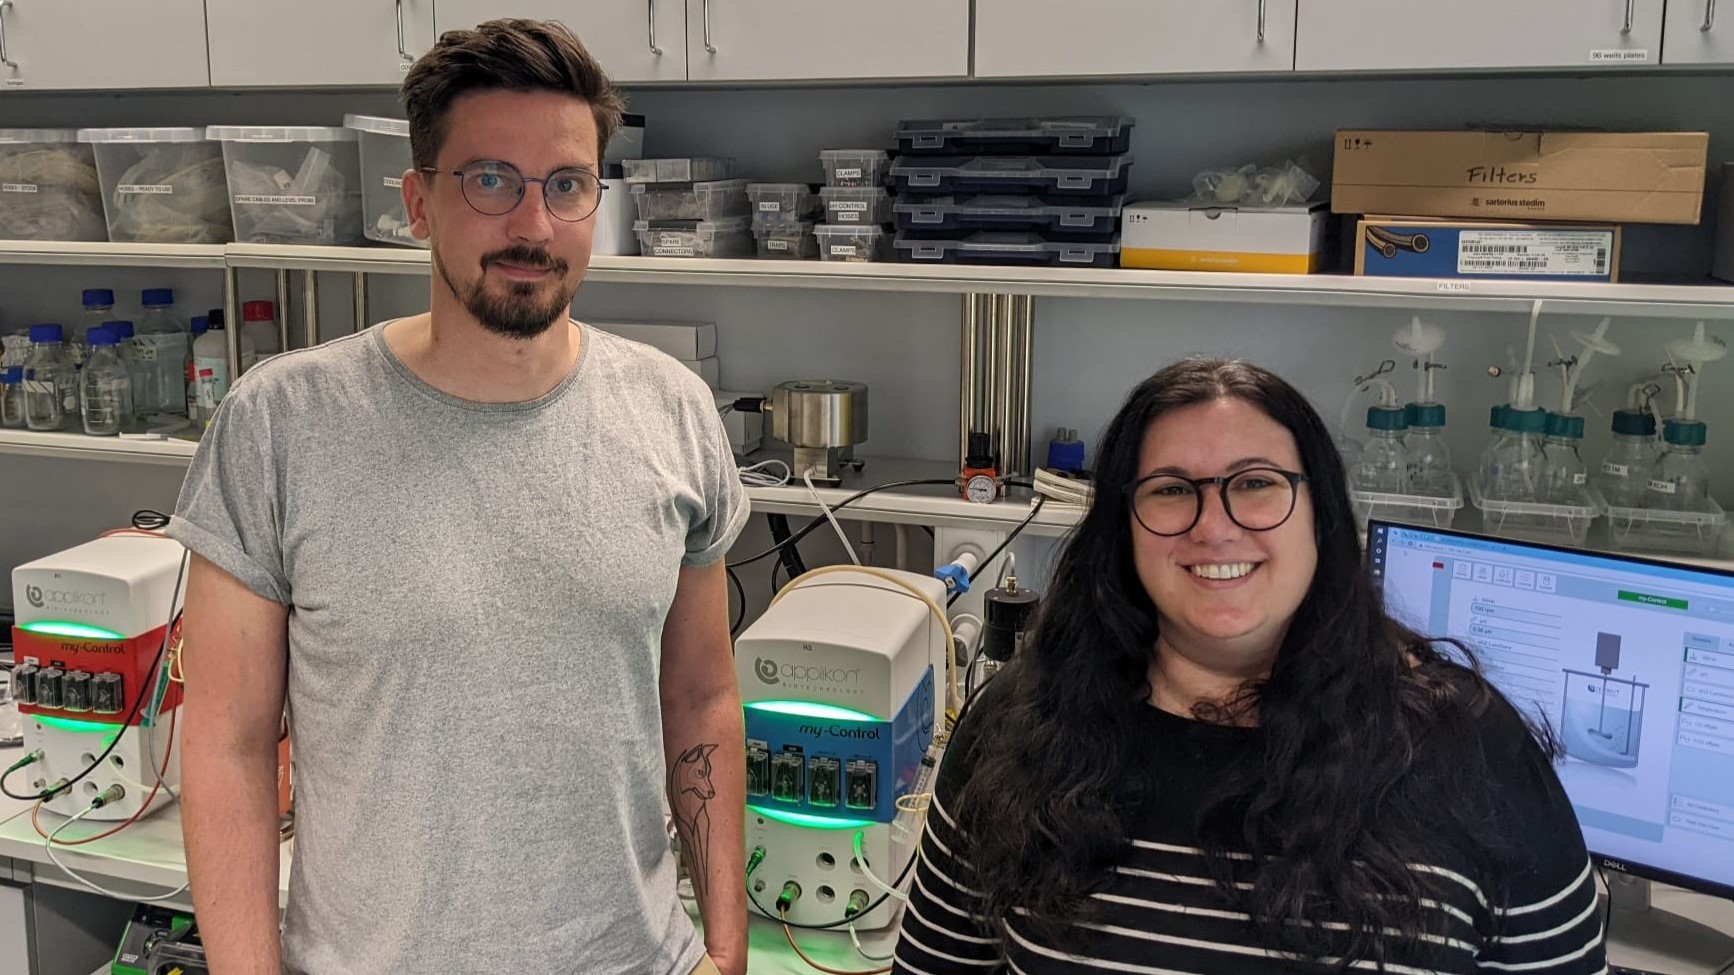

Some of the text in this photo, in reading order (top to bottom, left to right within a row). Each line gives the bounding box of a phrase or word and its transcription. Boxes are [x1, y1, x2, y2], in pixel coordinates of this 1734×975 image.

[1592, 51, 1645, 60] 96 wells plates
[836, 169, 860, 177] CLAMPS
[1466, 166, 1538, 183] Filters
[1486, 198, 1546, 207] sartorius stedim
[654, 247, 693, 255] CONNECTORS
[1438, 282, 1470, 290] FILTERS
[44, 588, 106, 607] applikon
[61, 641, 126, 655] my-Control
[780, 663, 861, 685] applikon
[782, 682, 864, 695] BIOTECHNOLOGY
[799, 724, 880, 740] my-Control
[1603, 859, 1627, 871] DELL
